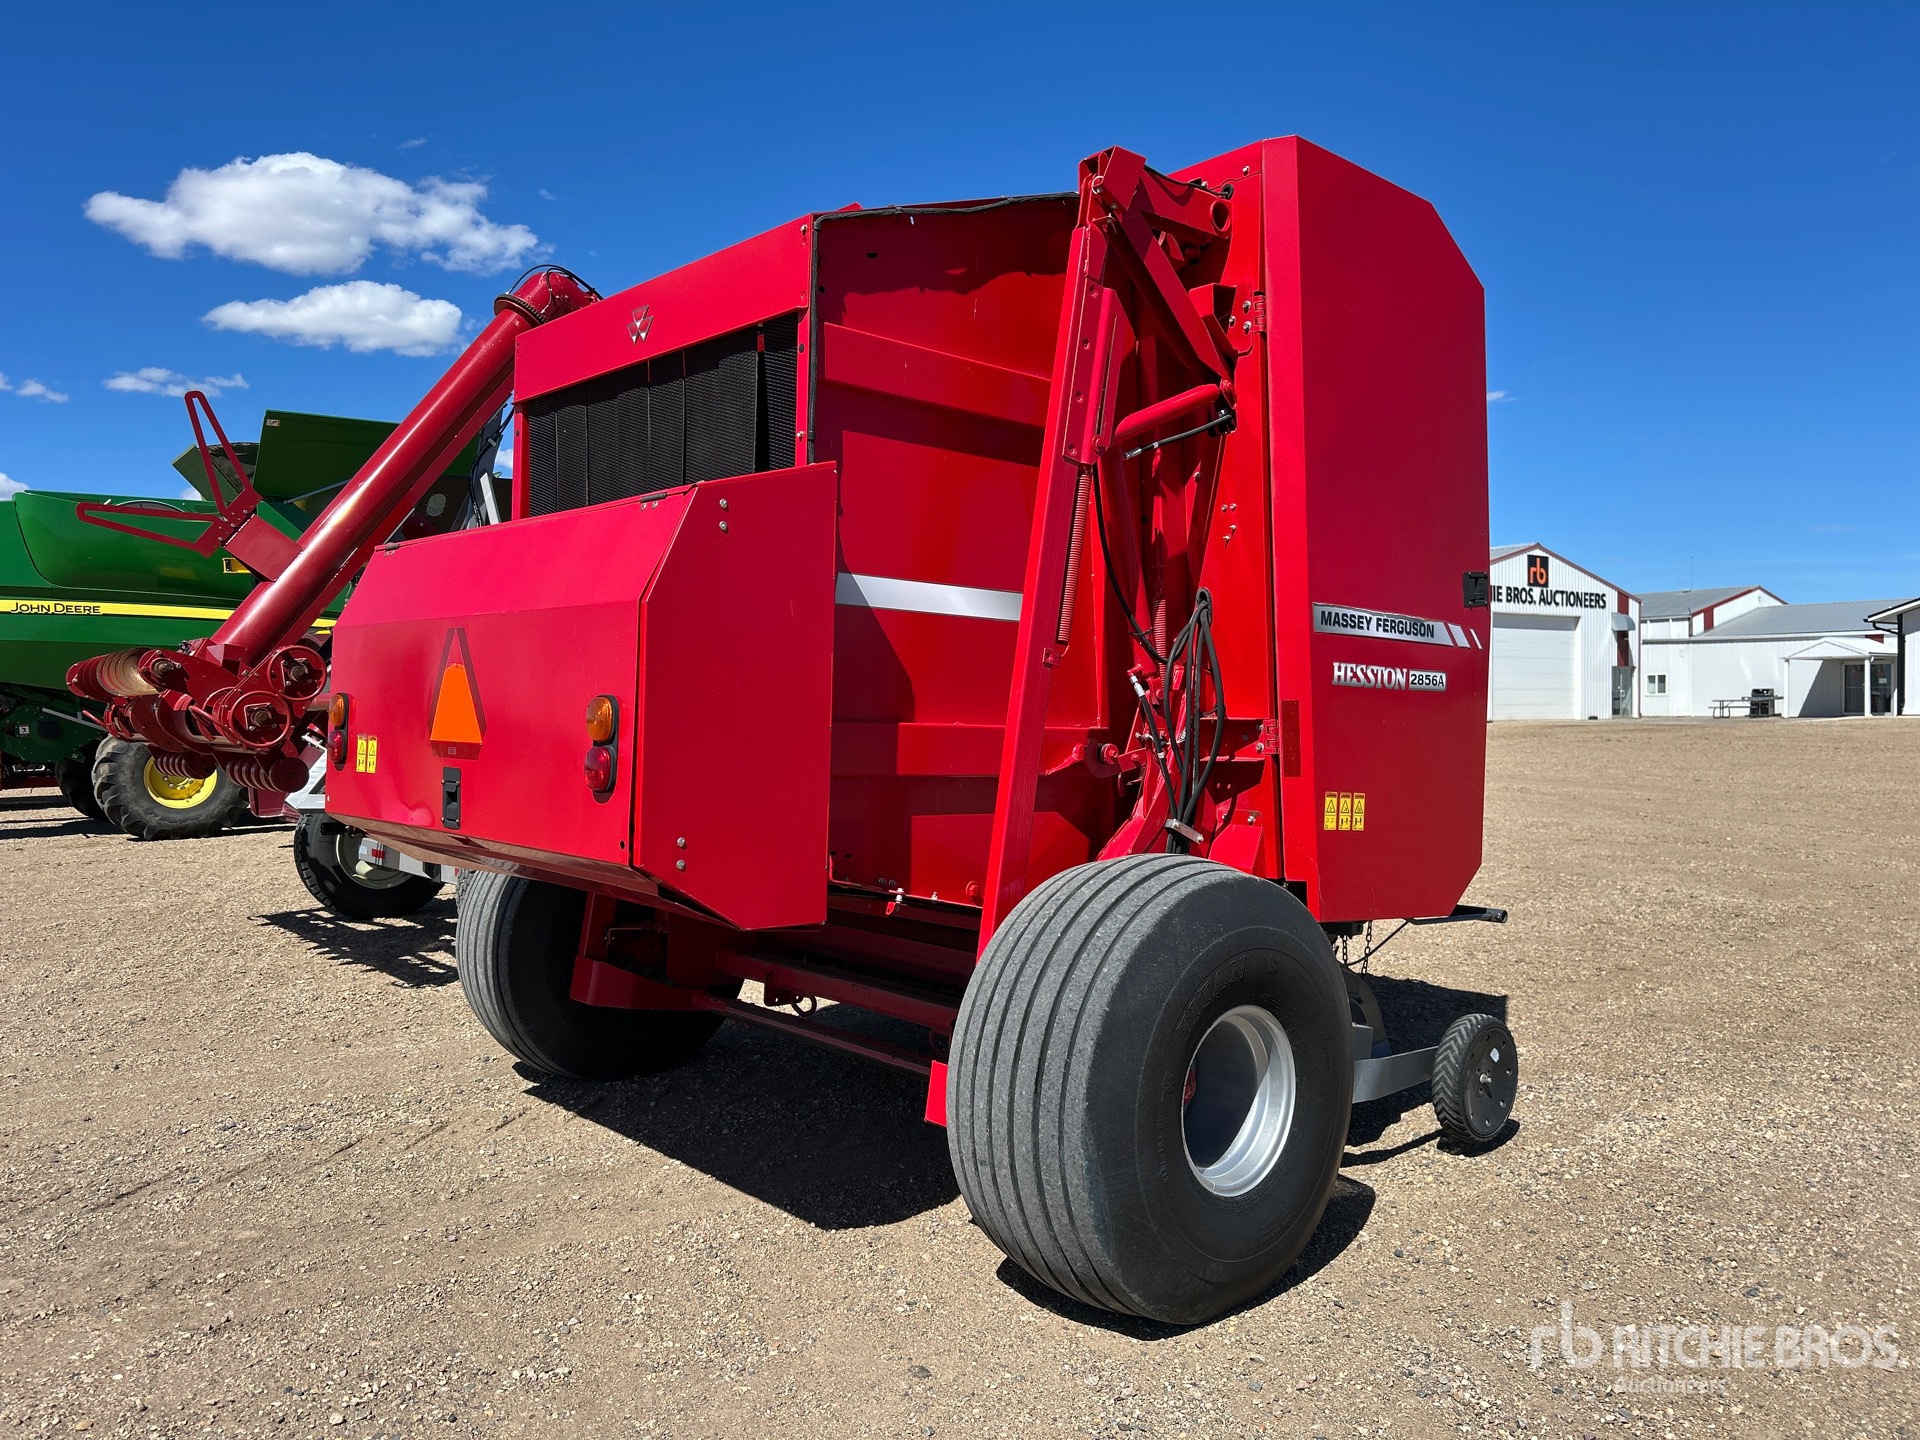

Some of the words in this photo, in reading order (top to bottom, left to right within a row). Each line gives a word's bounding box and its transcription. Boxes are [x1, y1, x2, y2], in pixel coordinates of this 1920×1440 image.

[1505, 586, 1536, 605] BROS.
[1538, 589, 1606, 609] AUCTIONEERS
[1320, 610, 1373, 631] MASSEY
[1375, 617, 1435, 638] FERGUSON
[1332, 661, 1408, 690] HESSTON
[1410, 673, 1445, 687] 2856A
